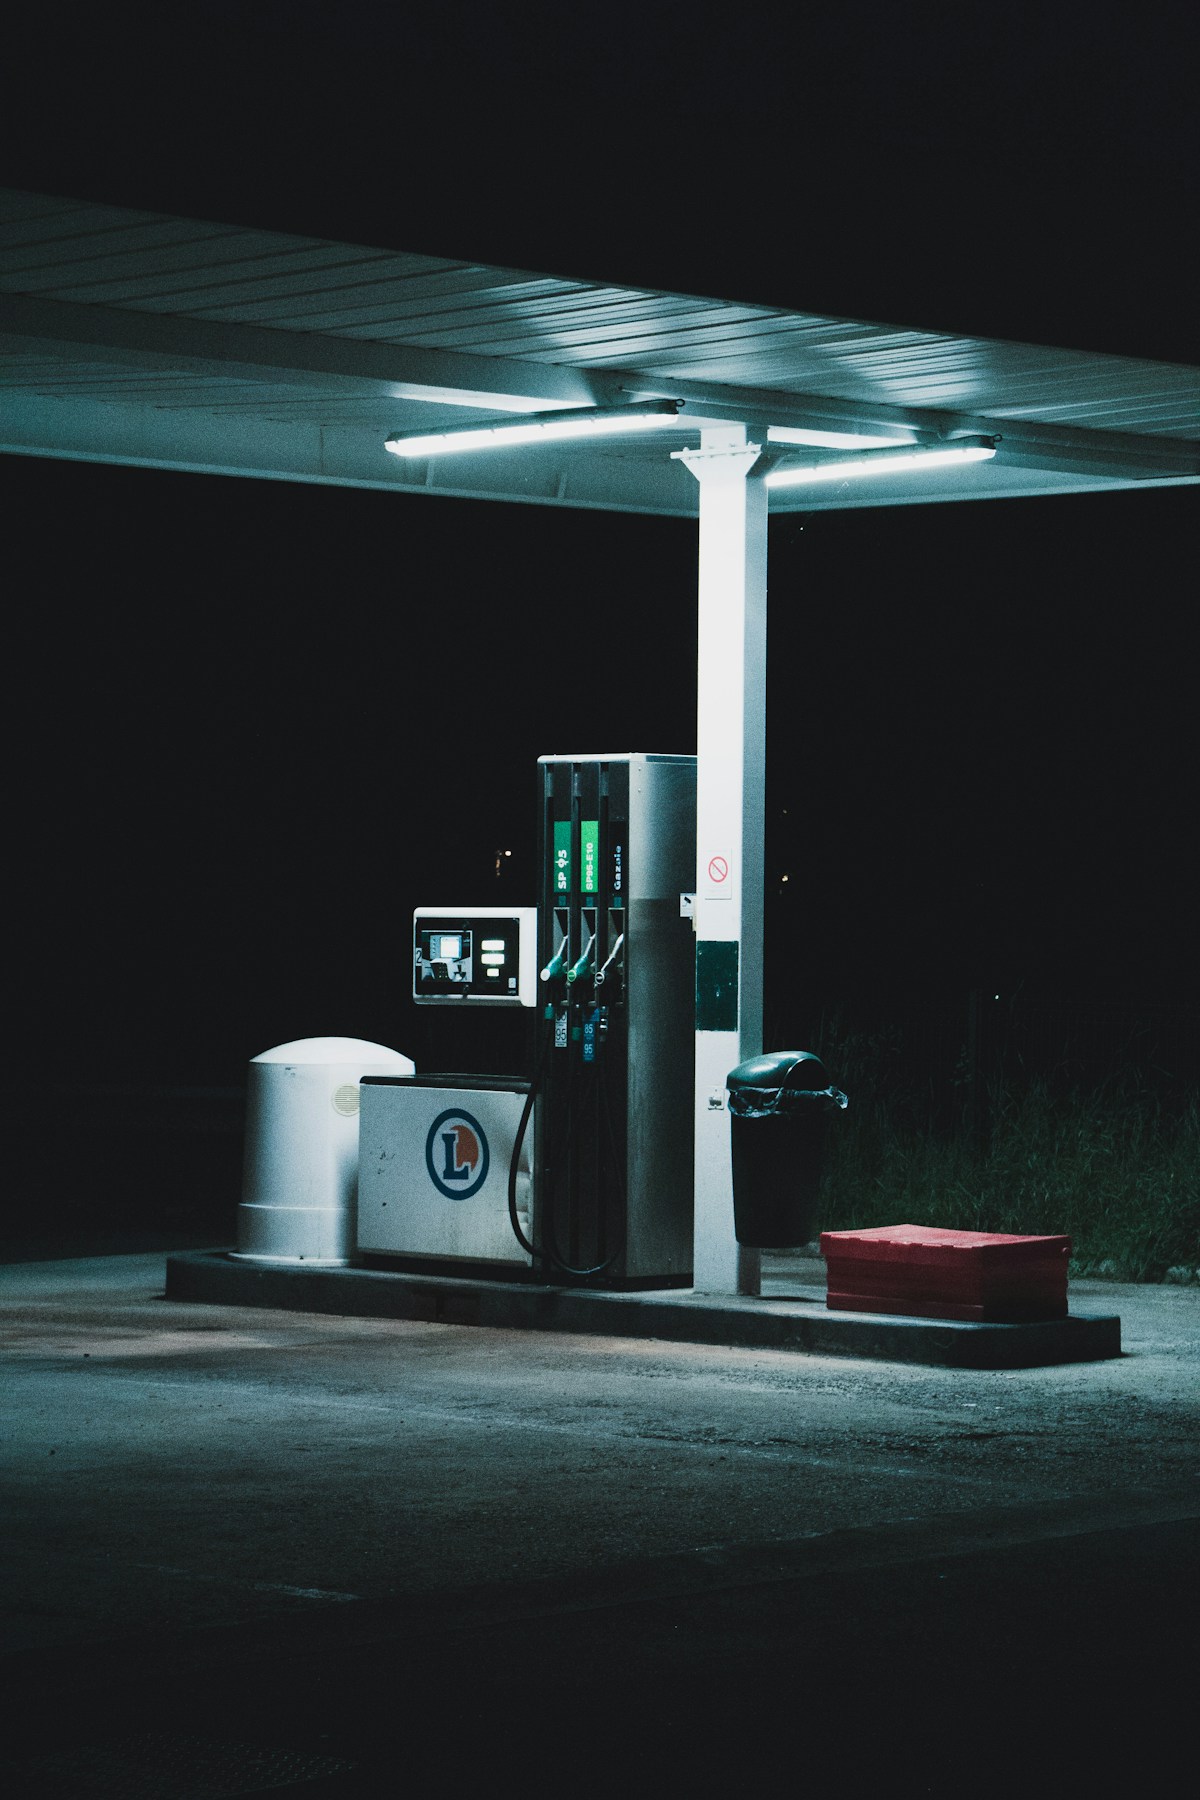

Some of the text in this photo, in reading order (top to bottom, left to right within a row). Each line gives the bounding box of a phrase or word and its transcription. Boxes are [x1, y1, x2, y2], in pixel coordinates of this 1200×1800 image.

[557, 871, 567, 890] SP
[416, 949, 422, 964] 2
[556, 1028, 566, 1041] 95
[584, 1043, 593, 1054] 95
[441, 1132, 469, 1180] L
